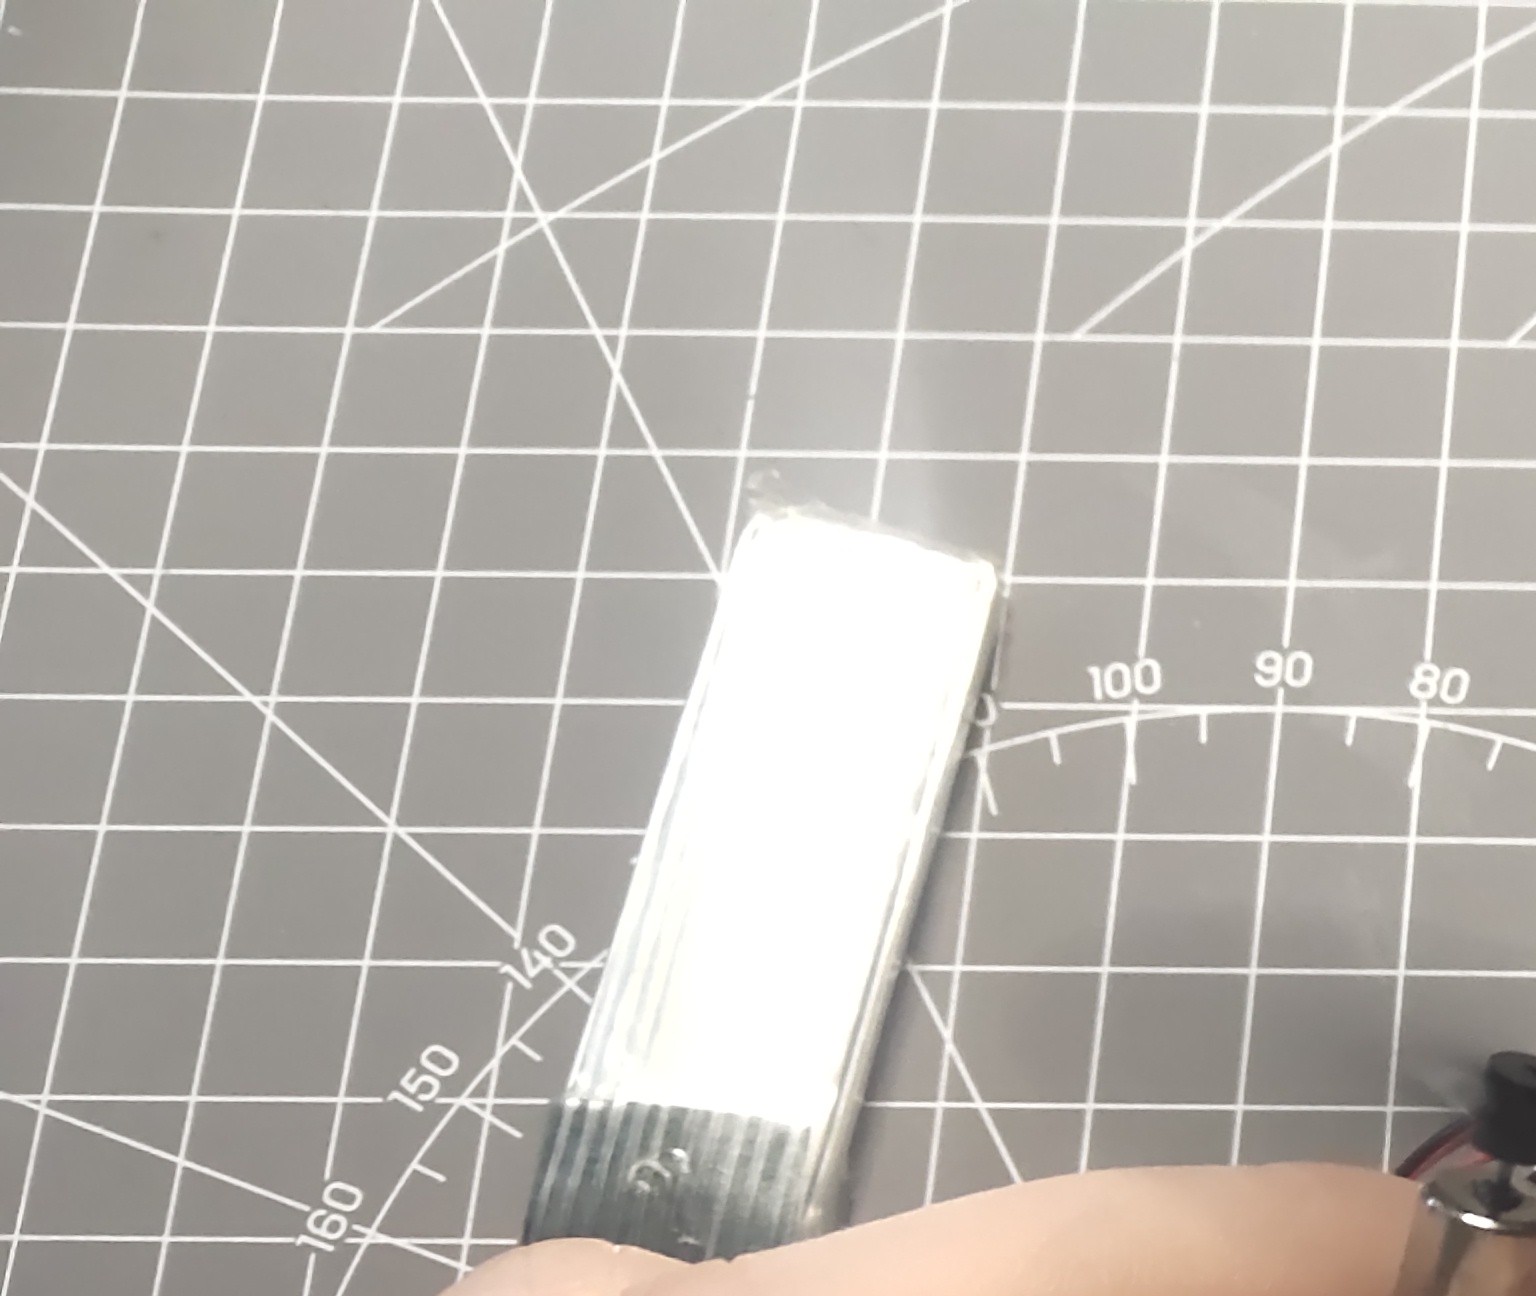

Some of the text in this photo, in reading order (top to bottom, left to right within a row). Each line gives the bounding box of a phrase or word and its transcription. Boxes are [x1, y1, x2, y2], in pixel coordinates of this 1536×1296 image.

[1087, 657, 1163, 701] 100
[1253, 649, 1315, 688] 90
[1408, 661, 1472, 704] 80
[498, 922, 578, 991] 140
[386, 1043, 463, 1114] 150
[295, 1179, 365, 1254] 160
